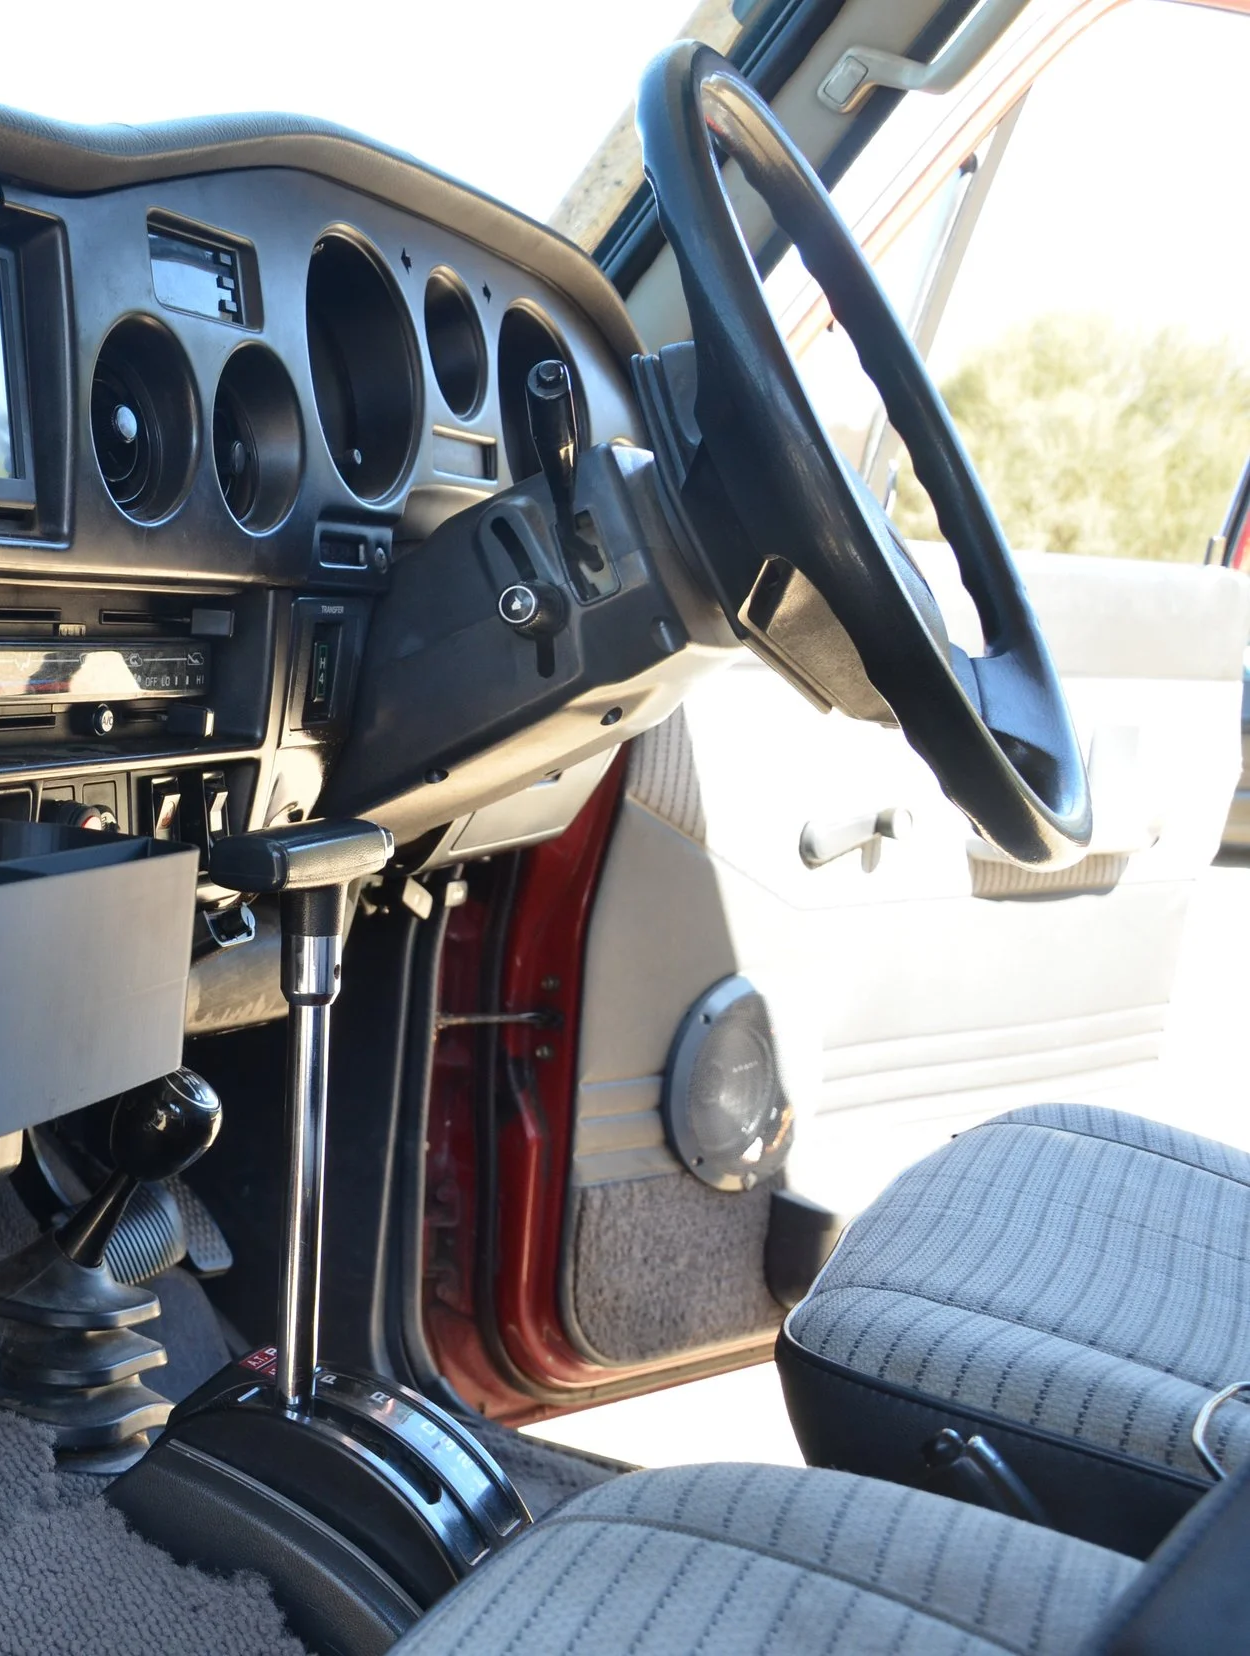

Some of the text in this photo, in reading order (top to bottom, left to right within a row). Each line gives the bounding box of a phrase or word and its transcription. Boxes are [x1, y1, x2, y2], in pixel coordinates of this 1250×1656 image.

[321, 605, 344, 614] TRANSFER
[145, 674, 205, 687] OFF LO HI
[319, 1374, 338, 1385] P
